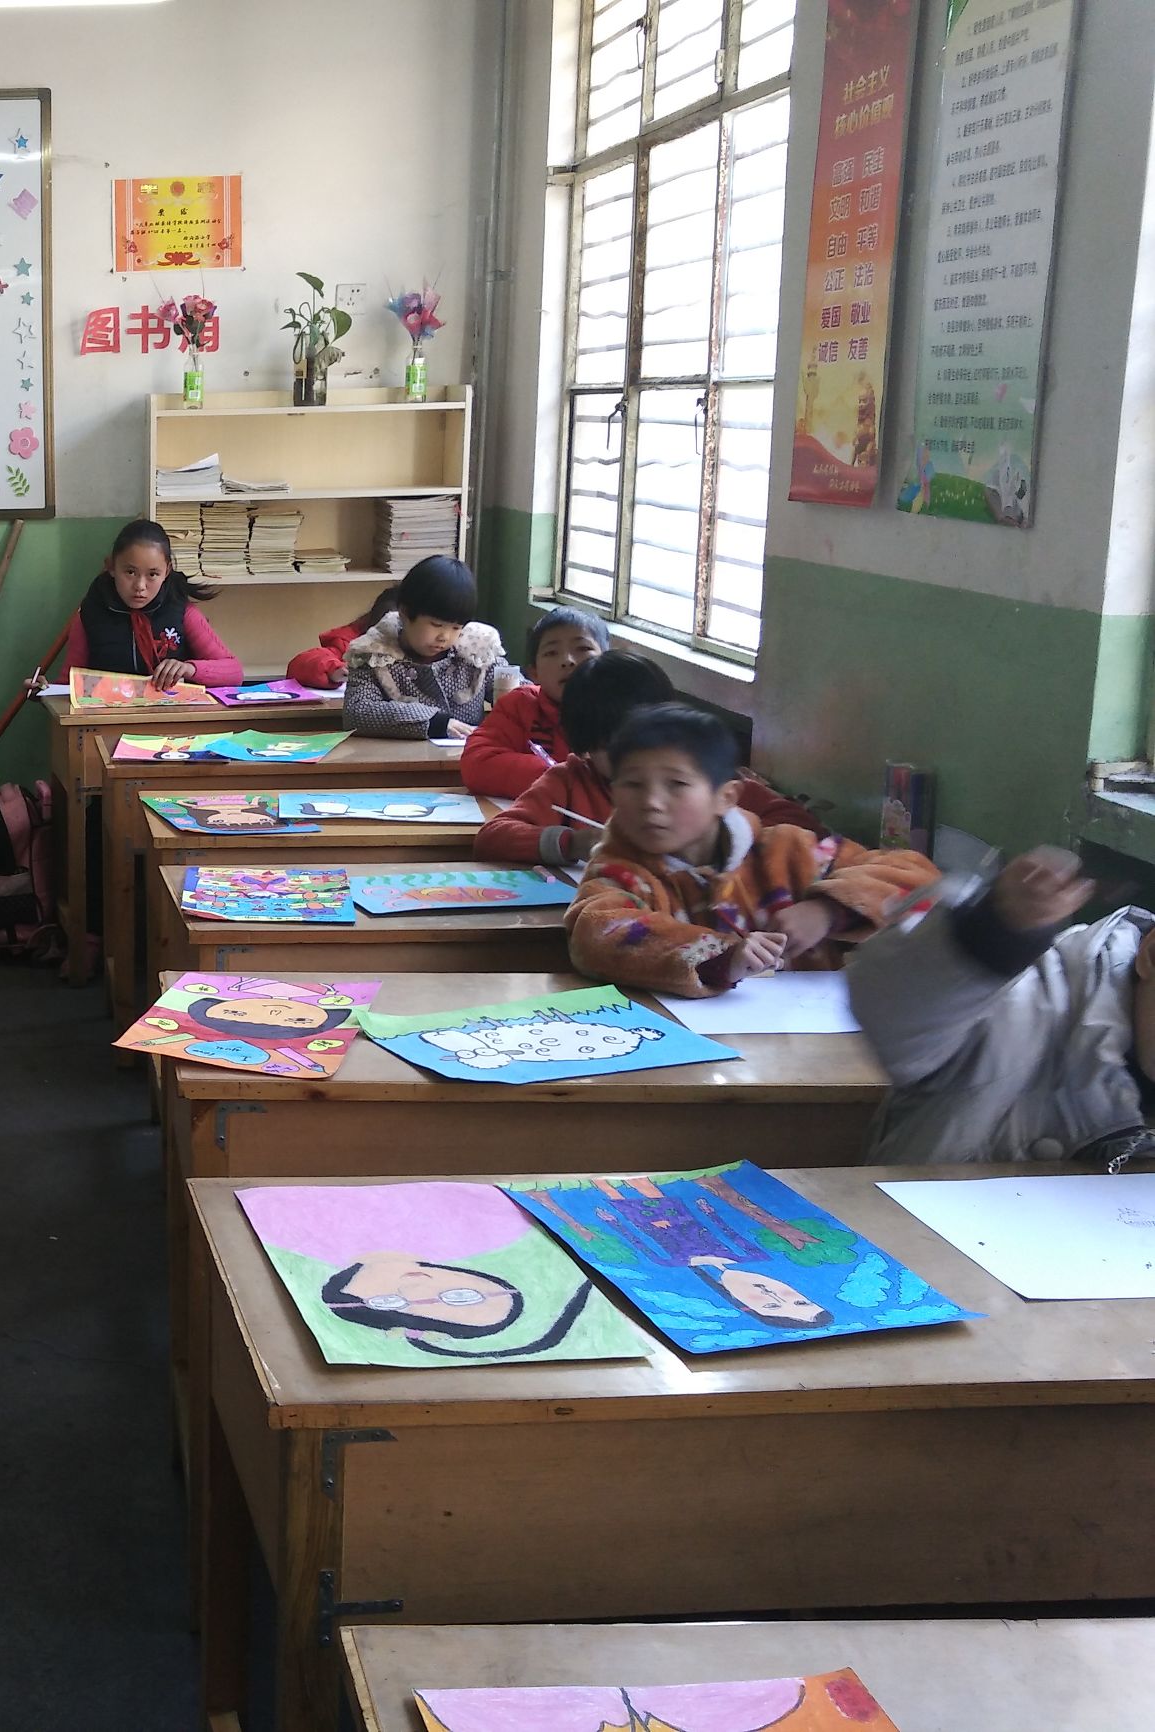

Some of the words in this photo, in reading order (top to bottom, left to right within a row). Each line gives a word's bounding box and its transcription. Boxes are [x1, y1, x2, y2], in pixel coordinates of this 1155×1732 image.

[844, 65, 890, 102] 社会主义
[829, 192, 851, 223] 文明
[858, 183, 882, 214] 和谐
[827, 231, 847, 260] 自由
[855, 223, 878, 253] 平等
[824, 268, 845, 292] 公正
[853, 262, 874, 288] 法治
[820, 305, 842, 329] 爱国
[850, 300, 871, 325] 敬业
[816, 341, 839, 363] 诚信
[847, 337, 868, 361] 友善
